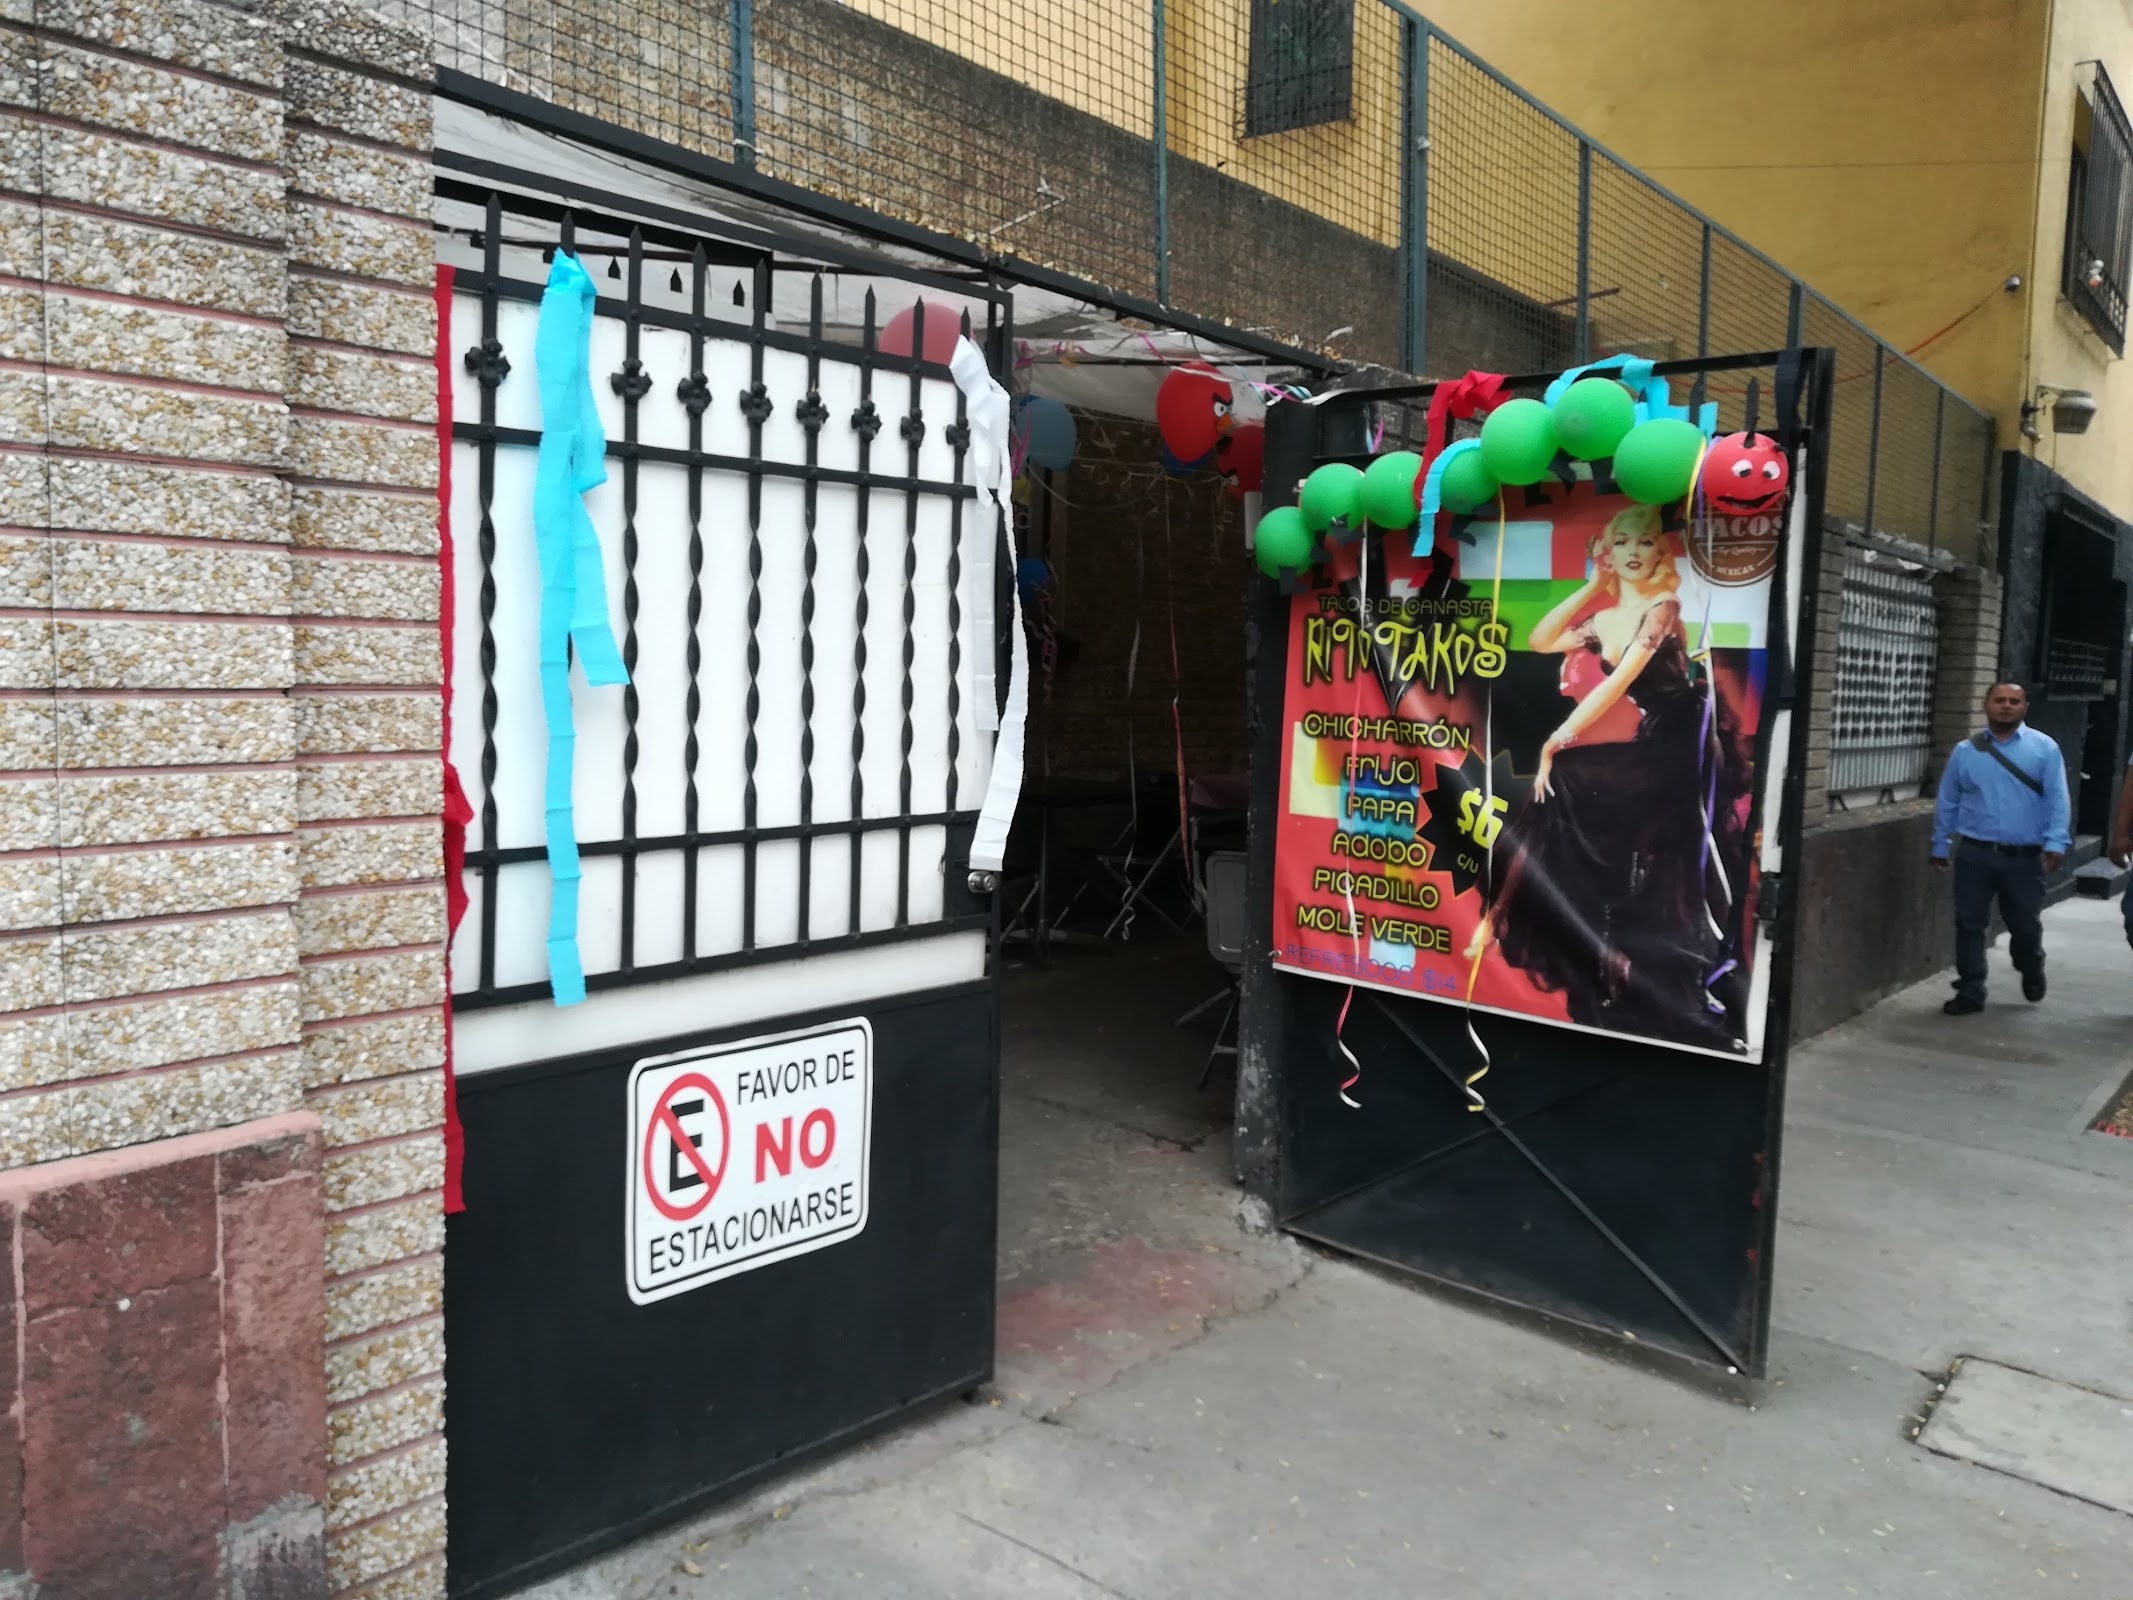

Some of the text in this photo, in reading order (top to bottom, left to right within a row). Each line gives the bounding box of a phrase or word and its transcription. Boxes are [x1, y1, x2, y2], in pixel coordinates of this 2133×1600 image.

[1318, 596, 1494, 617] TACOS DE CANASTA
[1304, 713, 1471, 750] CHICHARRÓN
[1348, 796, 1416, 824] PAPA
[1457, 787, 1509, 849] $6
[1314, 869, 1439, 909] PICADILLO
[1298, 905, 1450, 952] MOLE VERDE
[1286, 944, 1415, 986] REFRESCOS
[737, 1049, 855, 1105] FAVOR DE
[755, 1107, 838, 1185] NO
[649, 1181, 854, 1276] ESTACIONARSE
